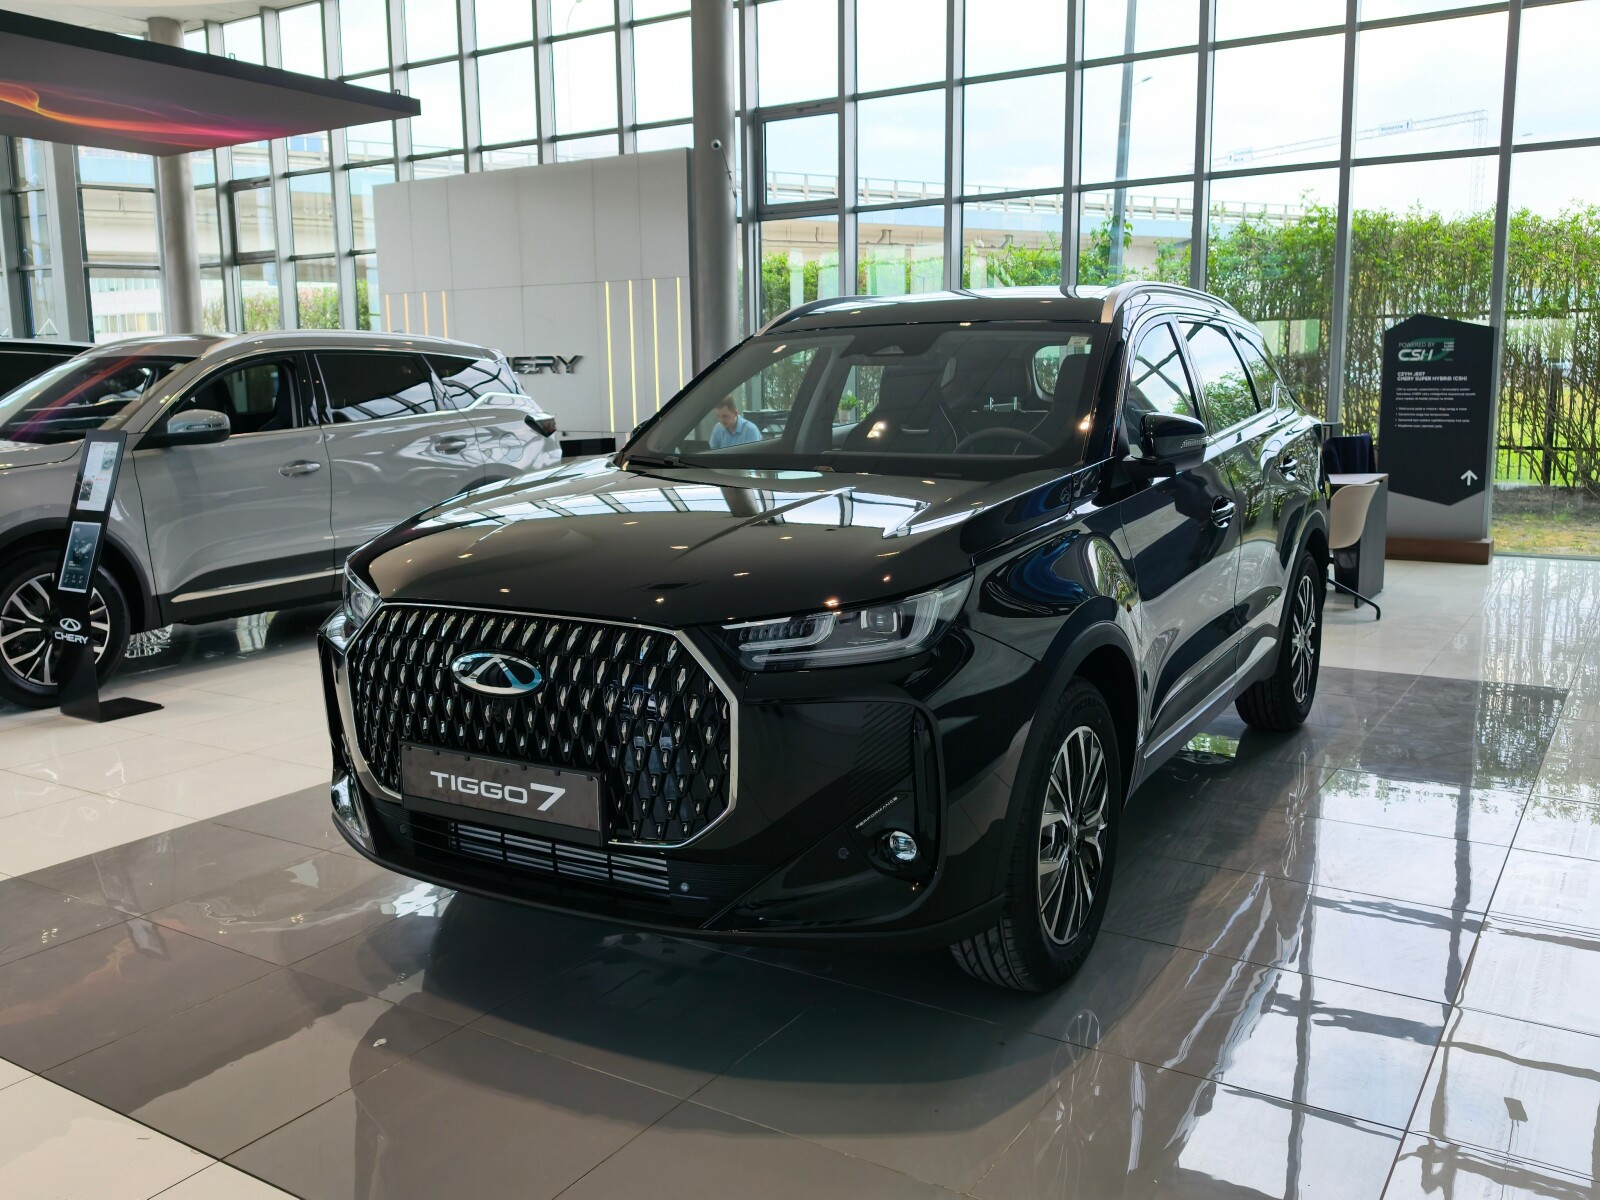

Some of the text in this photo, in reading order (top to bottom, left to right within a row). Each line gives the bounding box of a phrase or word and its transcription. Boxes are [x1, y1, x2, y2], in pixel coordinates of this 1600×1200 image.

[1398, 349, 1433, 361] CSH
[506, 355, 584, 374] ERY
[54, 631, 89, 645] CHERY
